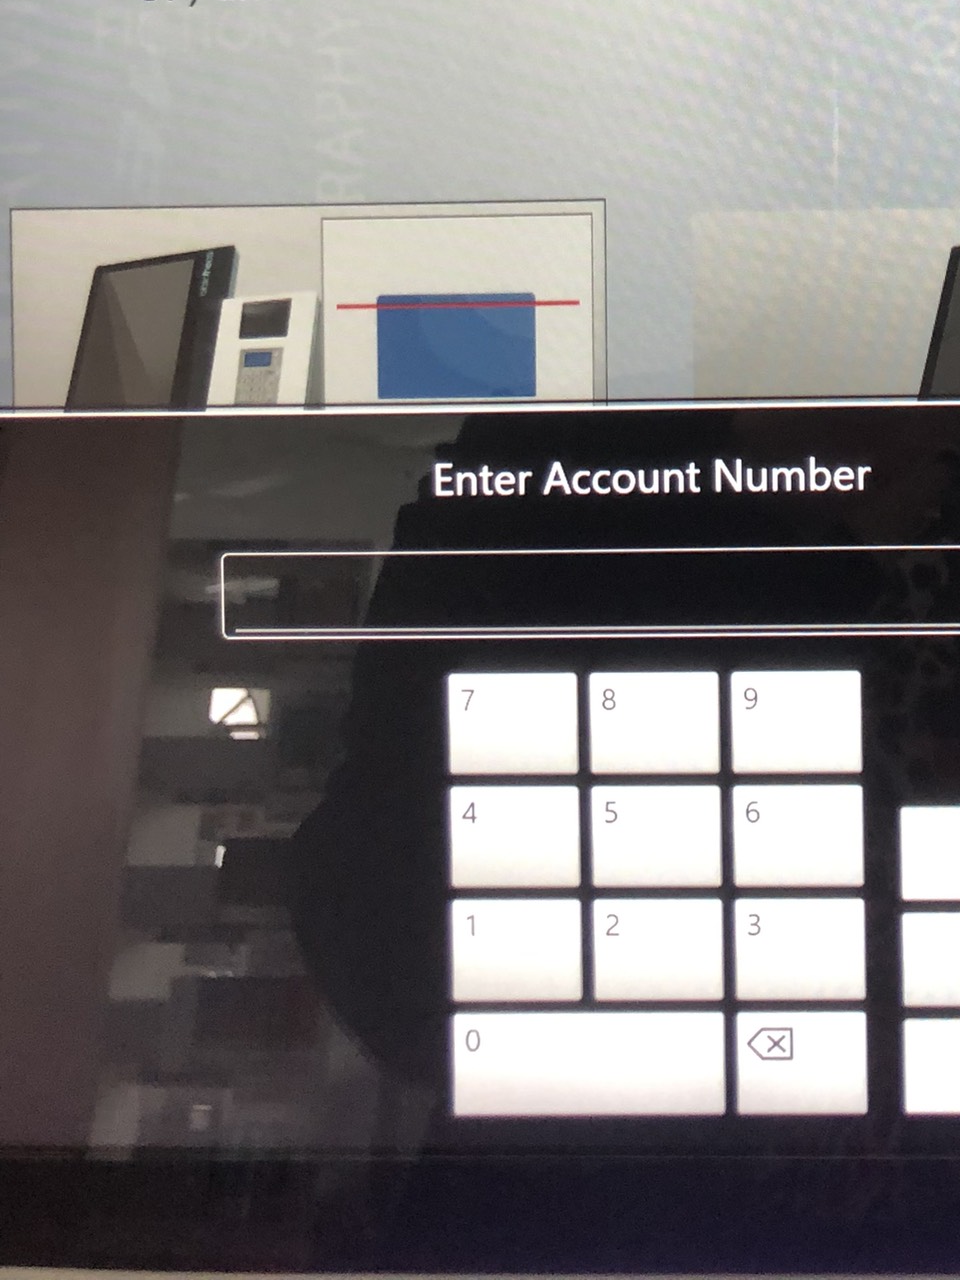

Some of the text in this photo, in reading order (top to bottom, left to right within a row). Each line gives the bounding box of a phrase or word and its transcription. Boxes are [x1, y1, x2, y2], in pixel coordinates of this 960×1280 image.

[432, 458, 876, 498] Enter Account Number
[461, 689, 475, 711] 7
[601, 688, 617, 711] 8
[743, 688, 759, 711] 9
[461, 801, 478, 823] 4
[603, 801, 618, 823] 5
[745, 801, 760, 823] 6
[466, 915, 476, 936] 1
[605, 914, 620, 937] 2
[747, 914, 762, 937] 3
[465, 1029, 481, 1052] 0
